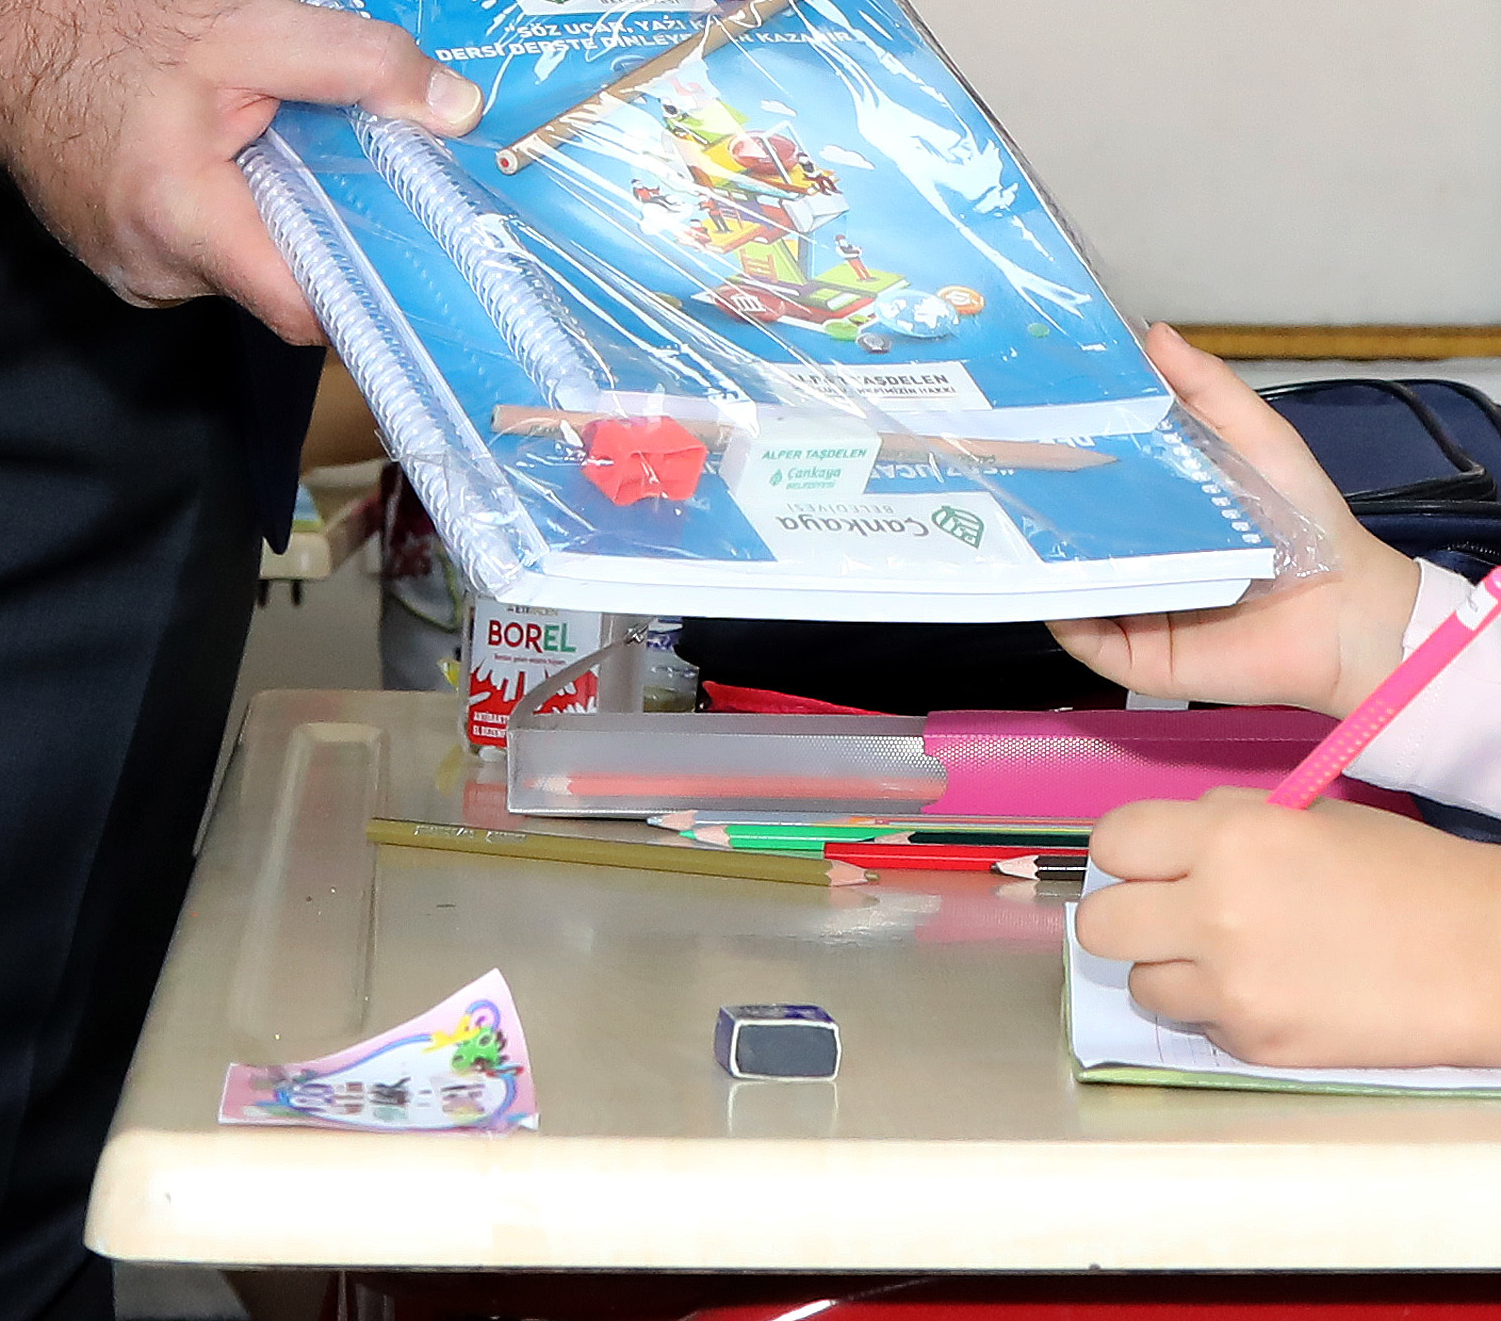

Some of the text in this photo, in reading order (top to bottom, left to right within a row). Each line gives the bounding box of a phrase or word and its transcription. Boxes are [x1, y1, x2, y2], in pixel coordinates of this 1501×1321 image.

[856, 373, 949, 387] AŞDELEN
[762, 449, 868, 461] ALPER TAŞDELEN
[776, 514, 929, 537] Çankaya
[487, 619, 577, 654] BOREL
